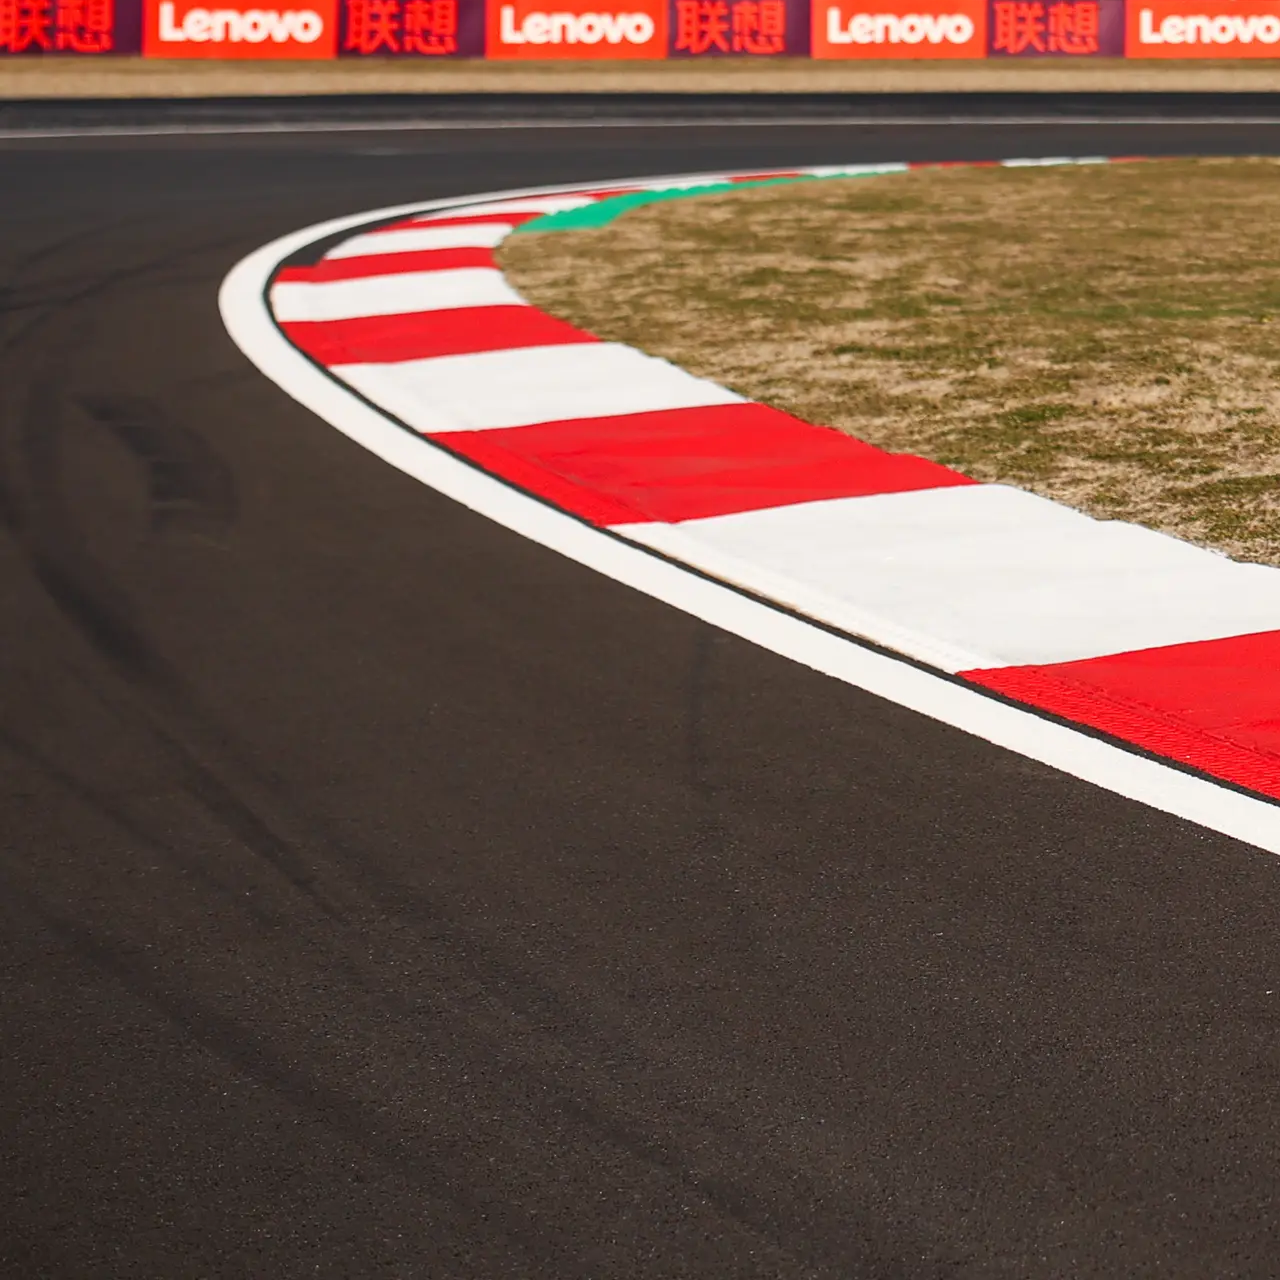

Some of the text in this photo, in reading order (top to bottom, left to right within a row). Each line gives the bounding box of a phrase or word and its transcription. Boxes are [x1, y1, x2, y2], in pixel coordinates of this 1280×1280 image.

[159, 2, 323, 43] Lenovo
[501, 6, 654, 44] Lenovo
[675, 0, 786, 54] 联想
[827, 7, 975, 44] Lenovo
[993, 0, 1098, 54] 联想
